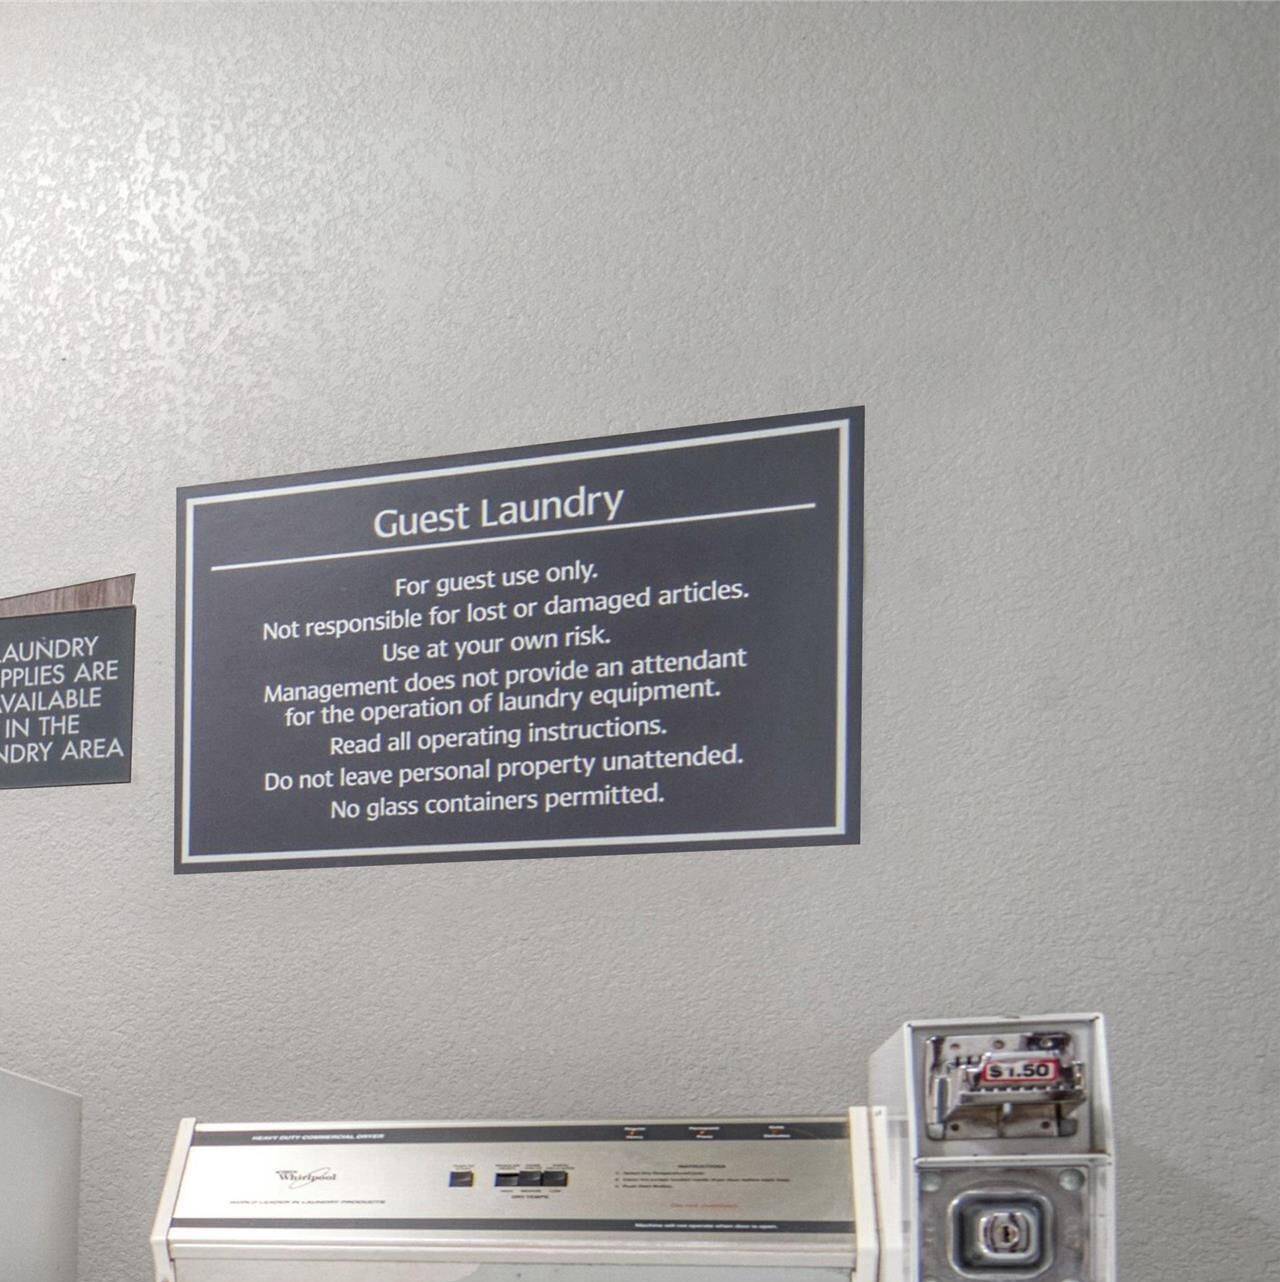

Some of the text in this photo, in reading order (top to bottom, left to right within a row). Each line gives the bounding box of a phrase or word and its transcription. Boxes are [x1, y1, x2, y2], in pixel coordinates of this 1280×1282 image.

[372, 484, 625, 539] Guest Laundry
[394, 558, 599, 598] For guest use only.
[262, 579, 750, 642] Not responsible for lost or damaged articles.
[381, 623, 611, 663] Use at your own risk.
[73, 659, 119, 683] ARE
[262, 647, 748, 704] Management does not provide an attendant
[283, 677, 721, 728] for the operation of laundry equipment.
[5, 714, 81, 739] IN THE
[329, 715, 668, 756] Read all operating instructions.
[60, 738, 125, 761] AREA
[263, 742, 744, 792] Do not leave personal property unattended.
[329, 781, 665, 822] No glass containers permitted.
[988, 1063, 1051, 1079] $1.50
